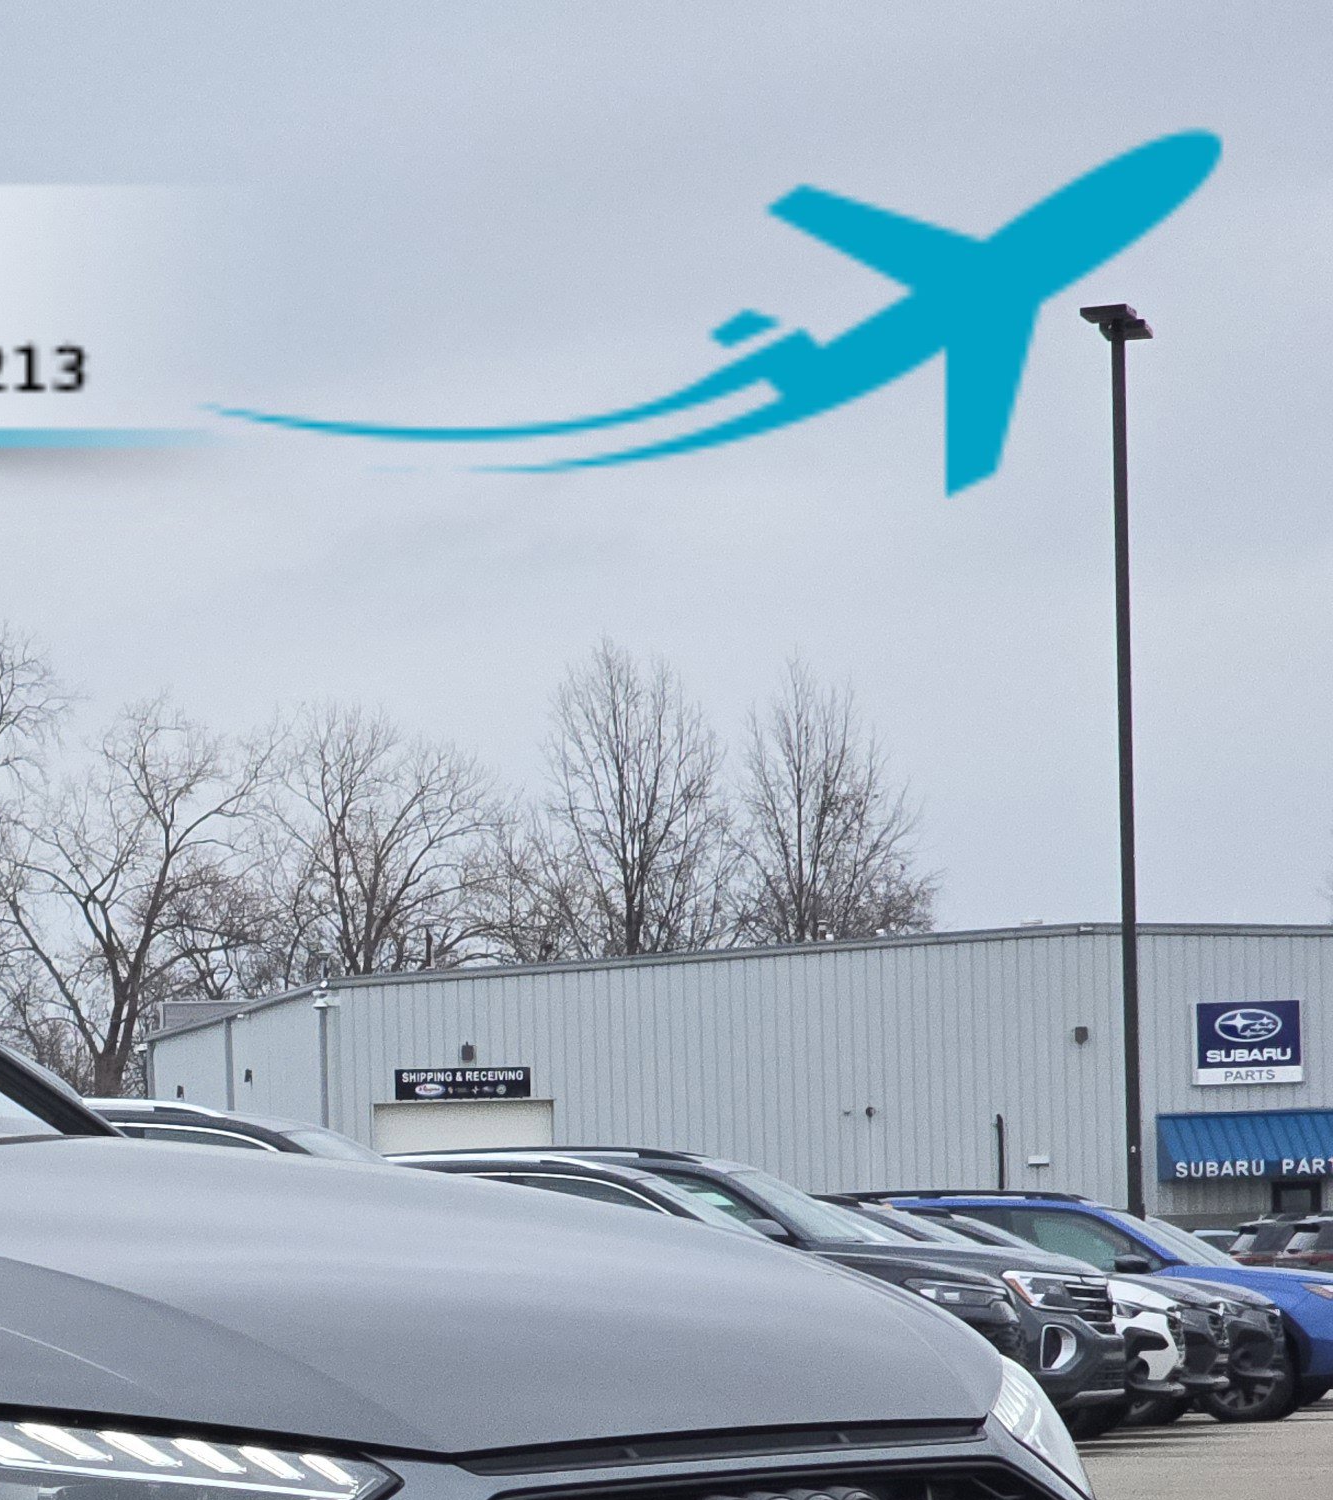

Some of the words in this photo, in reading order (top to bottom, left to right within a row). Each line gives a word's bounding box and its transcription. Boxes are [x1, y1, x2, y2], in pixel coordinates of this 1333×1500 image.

[1206, 1047, 1291, 1062] SUBARU
[402, 1072, 453, 1083] SHIPPING
[455, 1072, 463, 1082] &
[465, 1070, 524, 1082] RECEIVING
[1224, 1069, 1275, 1081] PARTS
[1175, 1157, 1265, 1177] SUBARU
